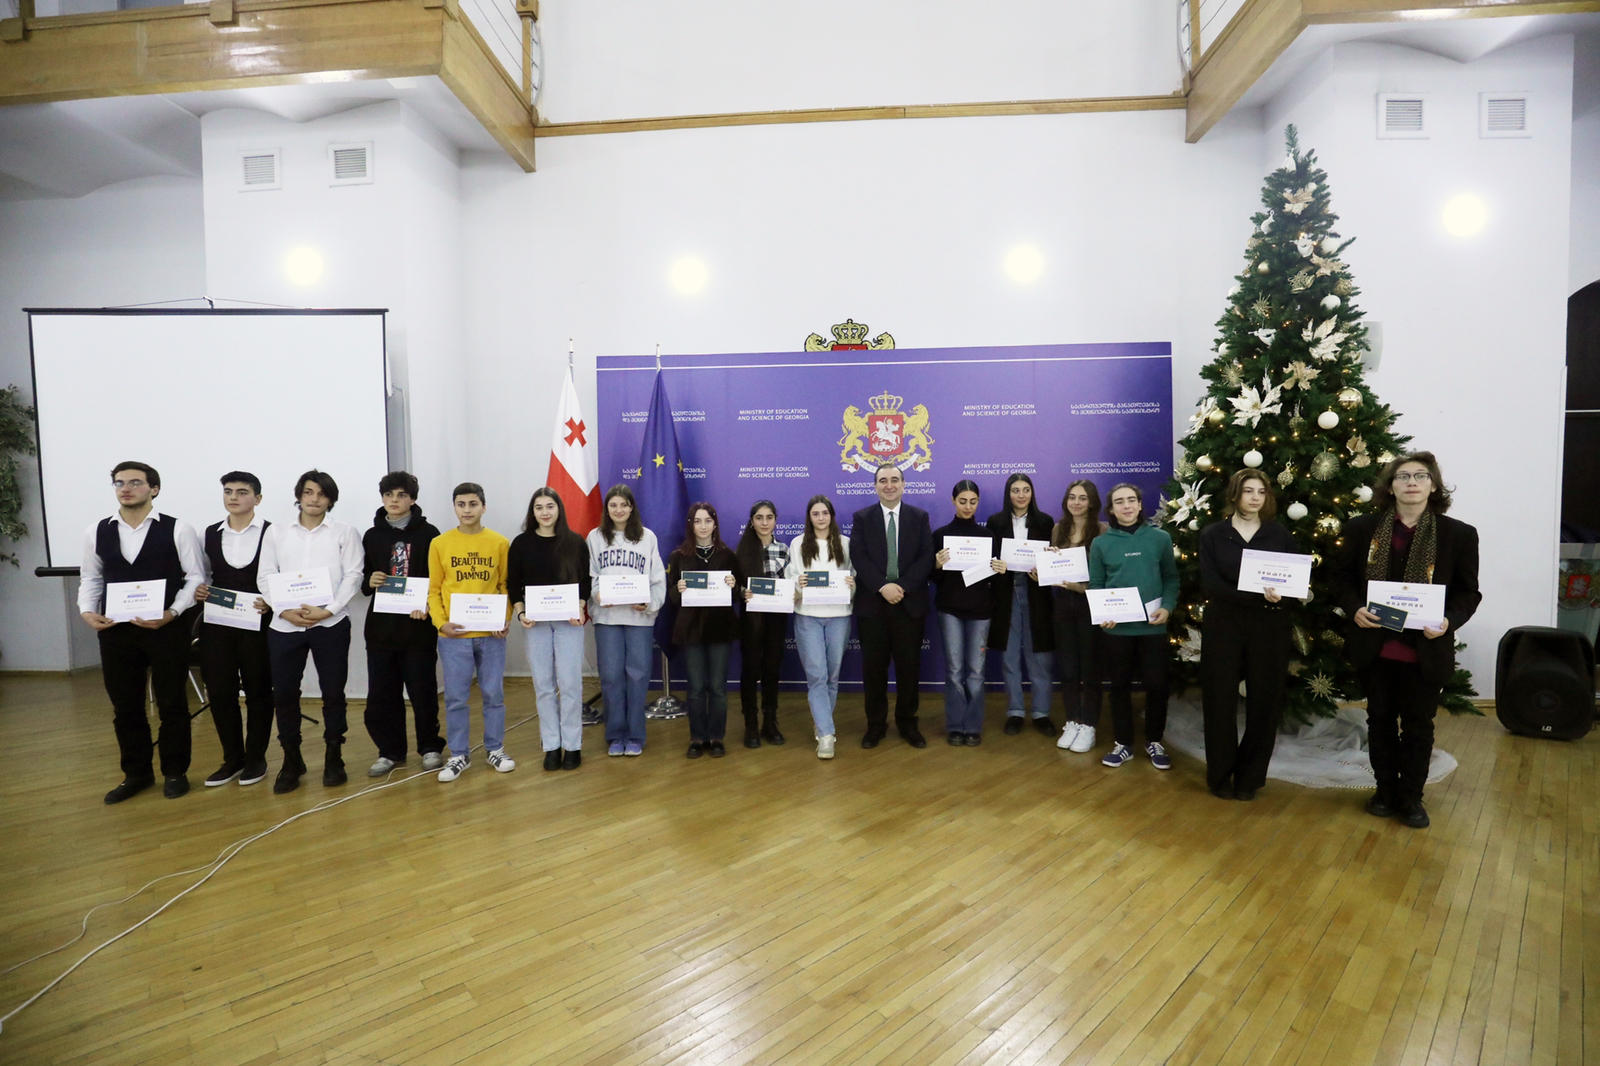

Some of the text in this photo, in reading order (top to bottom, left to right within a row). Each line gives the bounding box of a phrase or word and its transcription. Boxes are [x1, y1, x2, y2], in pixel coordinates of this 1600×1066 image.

[451, 556, 494, 568] BEAUTIFUL
[598, 548, 646, 574] ARCELONA
[456, 570, 490, 581] DAMNED
